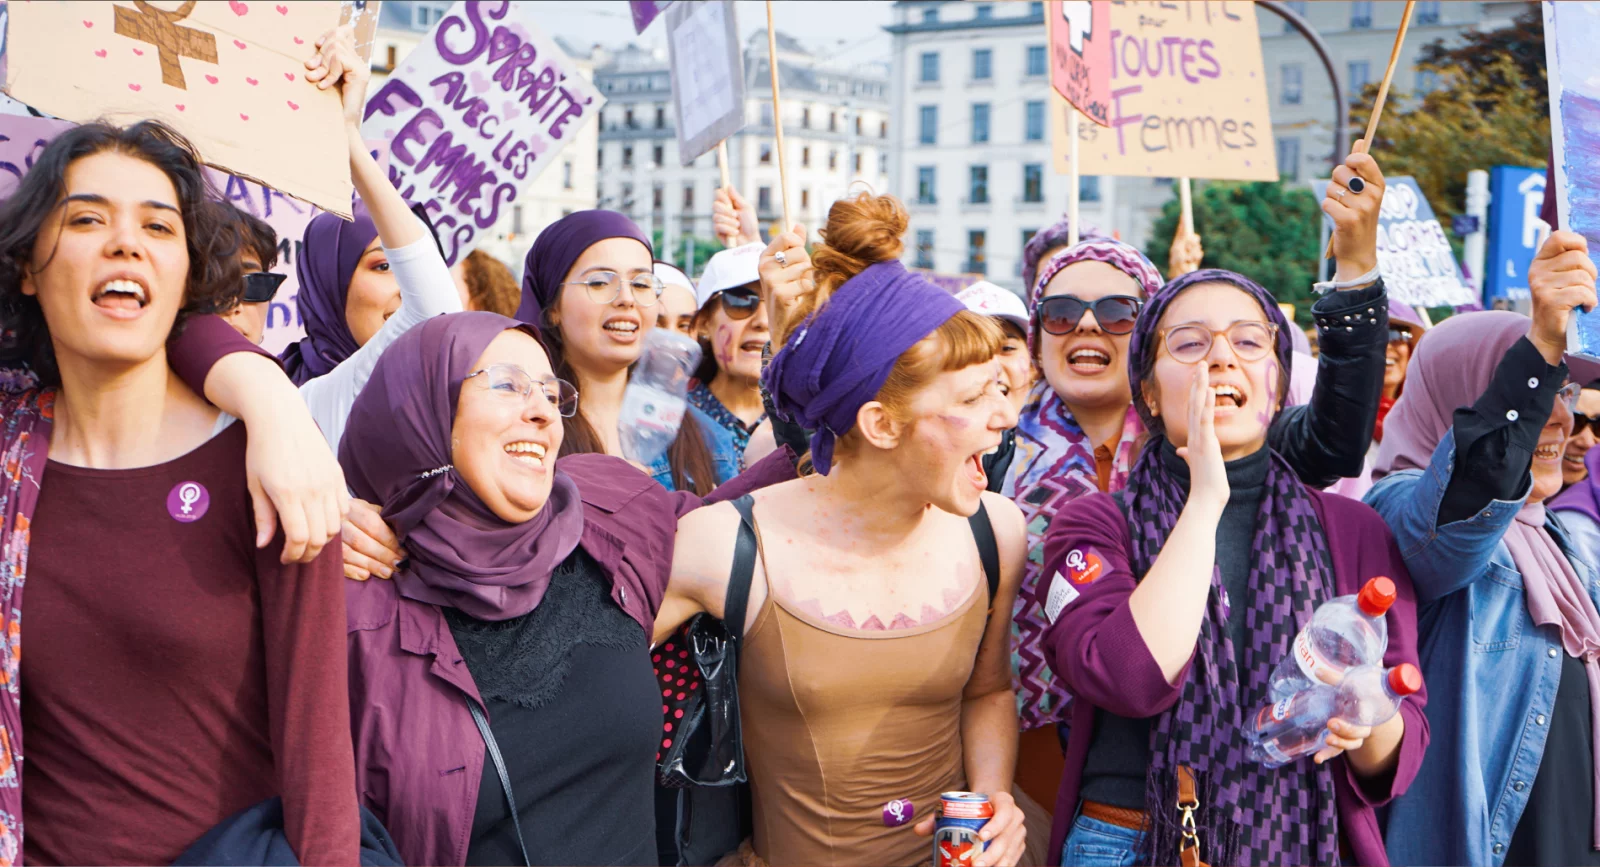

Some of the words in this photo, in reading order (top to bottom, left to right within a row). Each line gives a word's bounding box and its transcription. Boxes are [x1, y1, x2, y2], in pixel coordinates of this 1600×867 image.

[1110, 29, 1221, 84] TOUTES
[362, 78, 517, 229] FEMMES
[429, 71, 500, 140] AVEC
[492, 129, 537, 180] LES
[1111, 84, 1258, 156] Femmes
